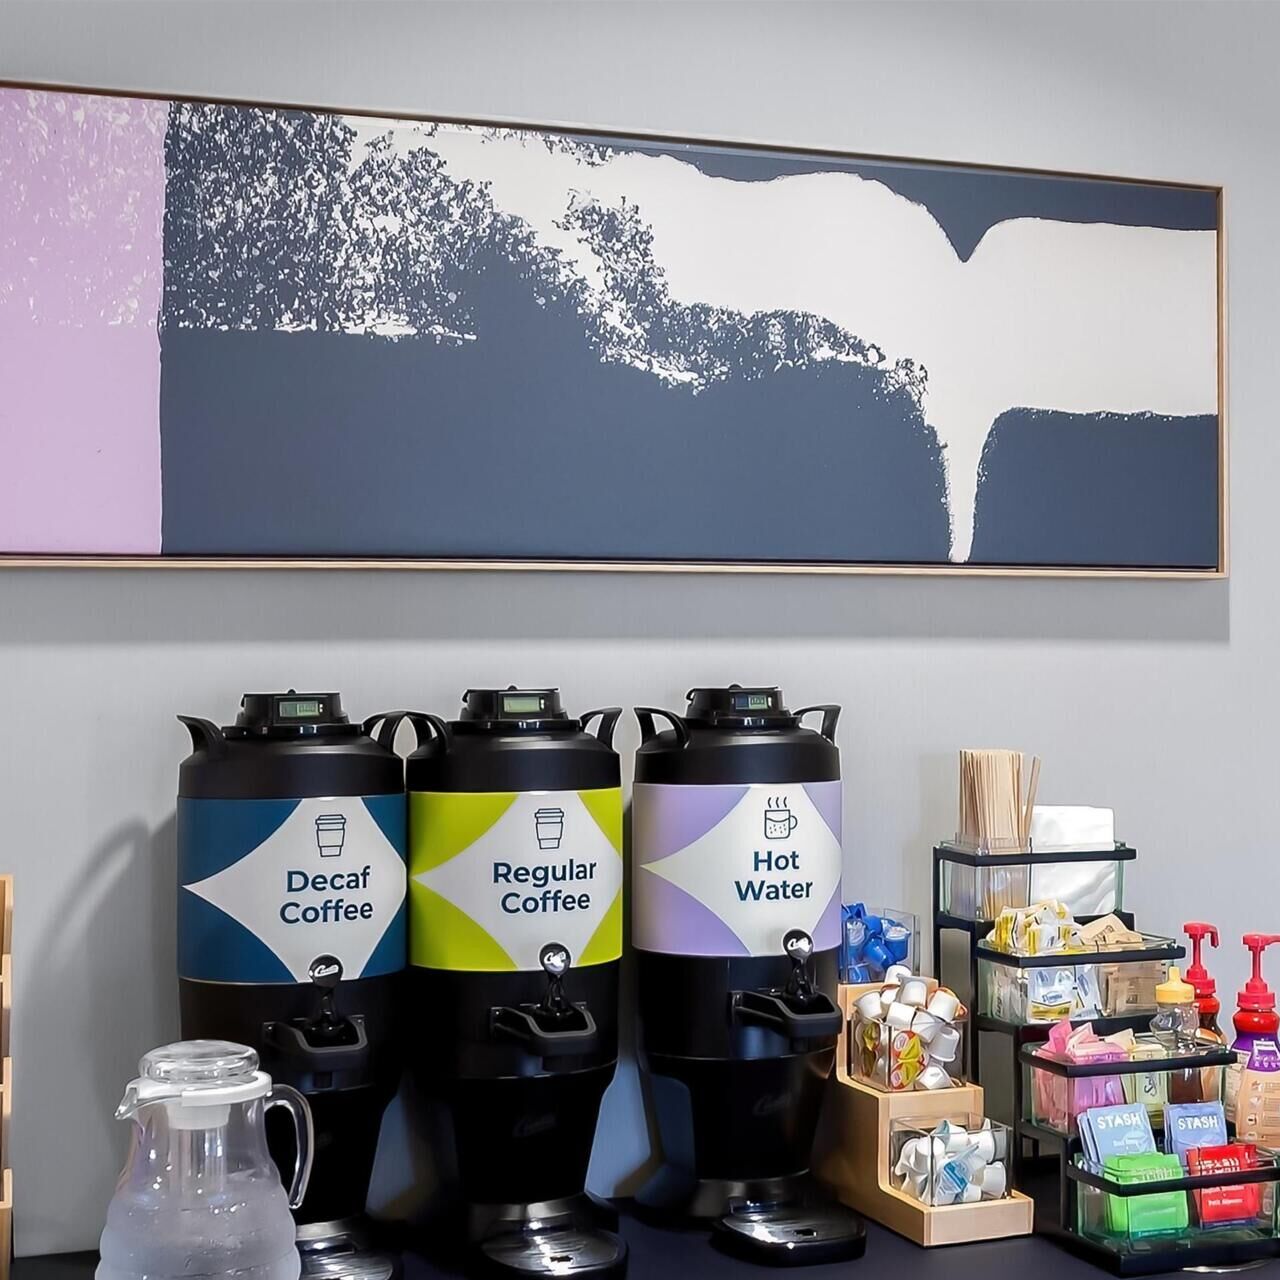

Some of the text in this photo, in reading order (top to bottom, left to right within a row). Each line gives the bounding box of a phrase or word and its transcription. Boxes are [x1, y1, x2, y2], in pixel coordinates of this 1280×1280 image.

[753, 850, 800, 872] Hot
[286, 864, 371, 893] Decaf
[493, 858, 597, 888] Regular
[501, 889, 591, 914] Coffee
[734, 879, 813, 901] Water
[279, 898, 373, 924] Coffee
[1097, 1112, 1142, 1130] STASH
[1177, 1115, 1219, 1130] STASH
